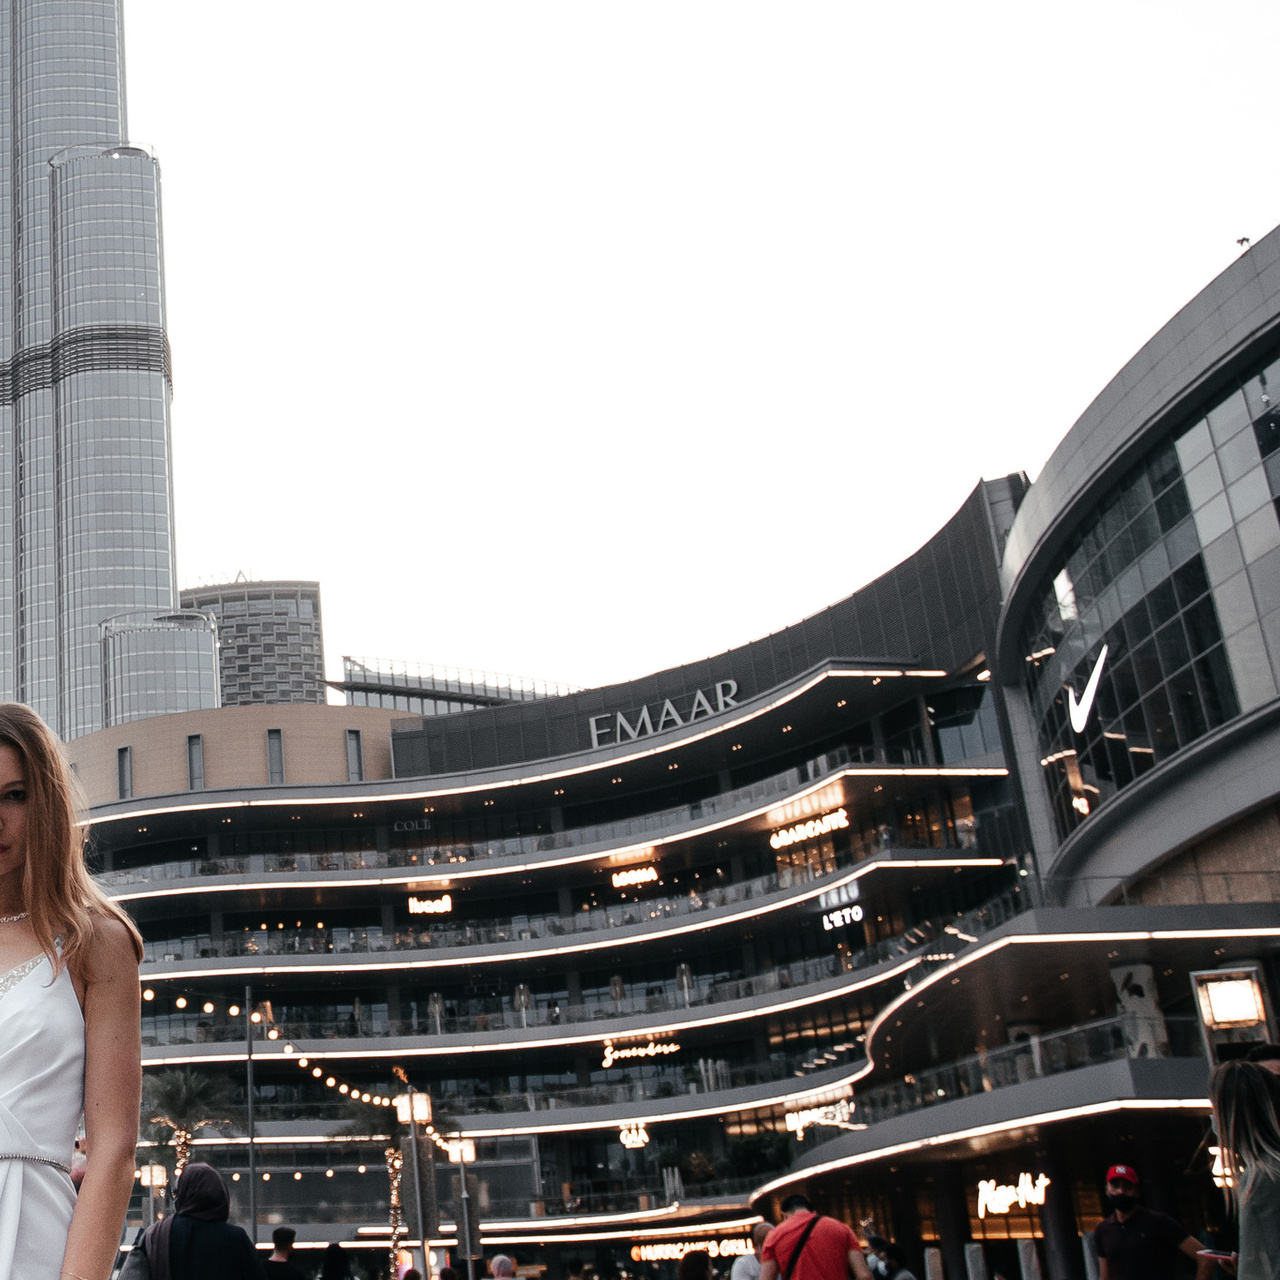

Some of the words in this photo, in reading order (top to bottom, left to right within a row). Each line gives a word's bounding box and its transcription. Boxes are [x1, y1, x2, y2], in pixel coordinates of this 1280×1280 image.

[589, 678, 739, 749] EMAAR
[822, 905, 863, 931] L'ETO
[619, 1127, 650, 1145] GIA
